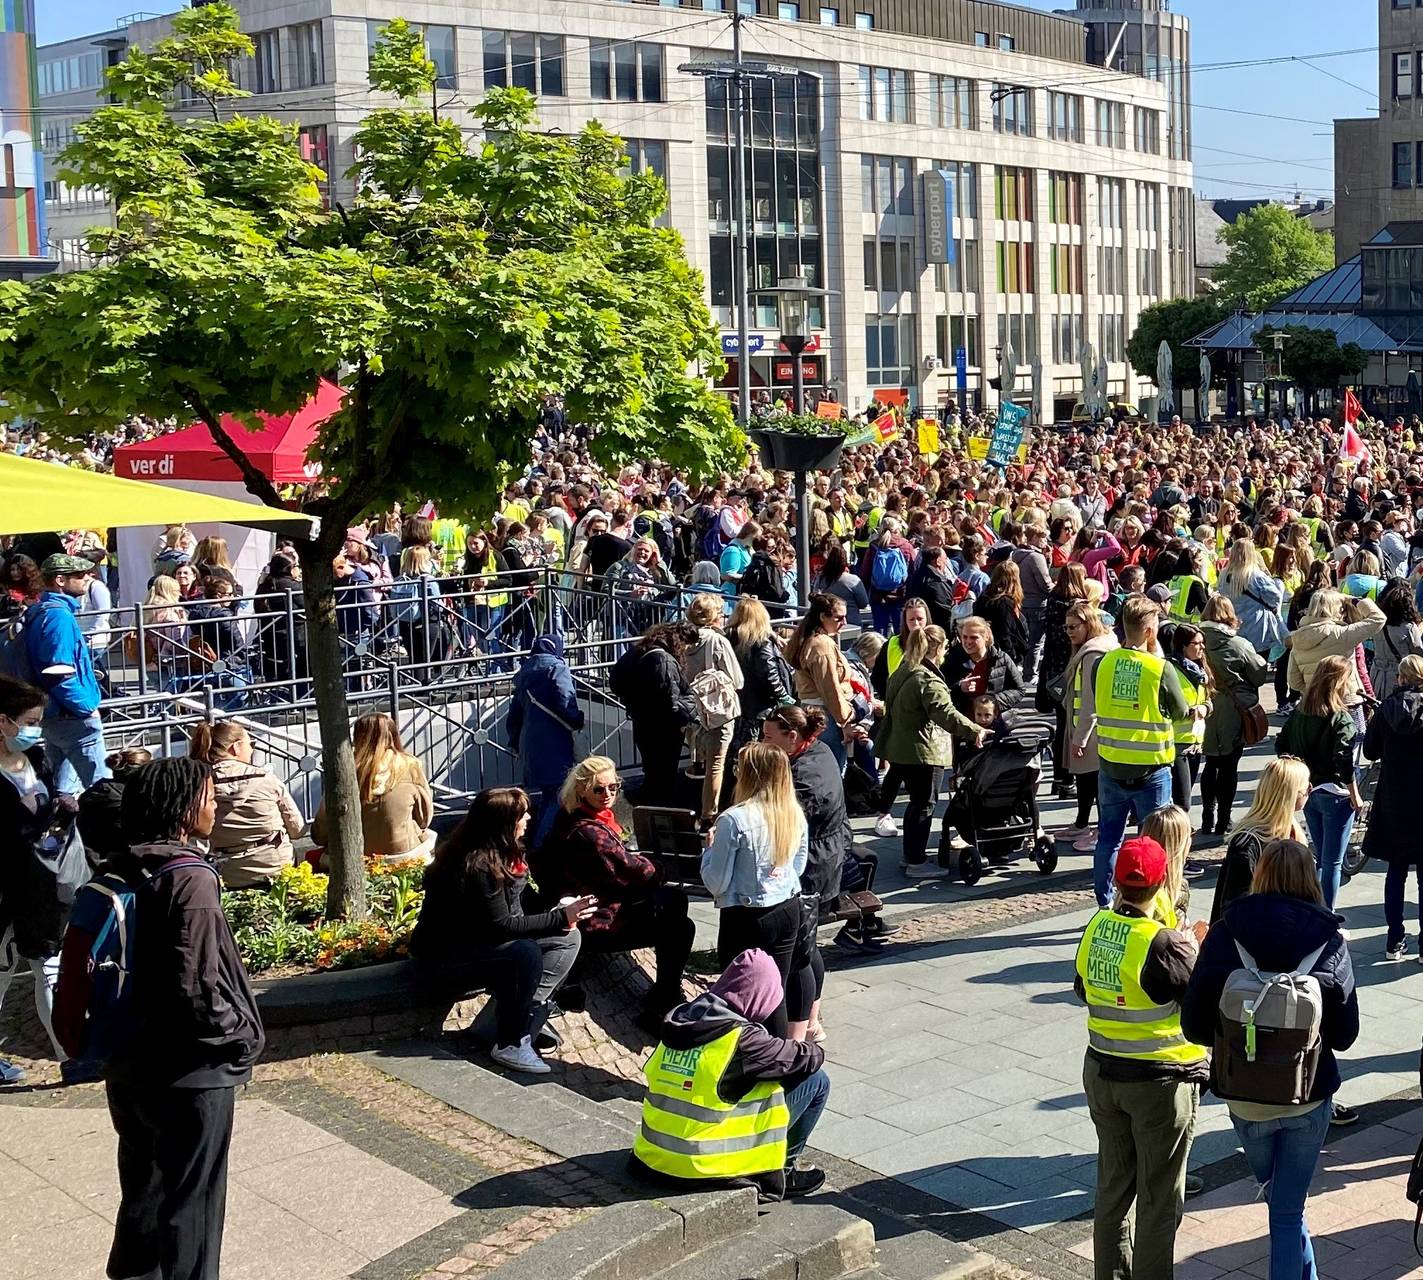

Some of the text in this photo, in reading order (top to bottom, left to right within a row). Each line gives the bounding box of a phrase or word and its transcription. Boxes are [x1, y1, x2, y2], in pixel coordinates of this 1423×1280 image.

[928, 181, 943, 257] cyberport
[725, 338, 760, 348] cybort
[780, 367, 815, 375] EINNG
[1115, 658, 1142, 672] MEHR
[1112, 683, 1139, 697] MEHR
[1093, 917, 1132, 945] MEHR
[1088, 943, 1126, 966] BRAUCHT
[1087, 957, 1122, 985] MEHR
[663, 1047, 701, 1070] MEHR
